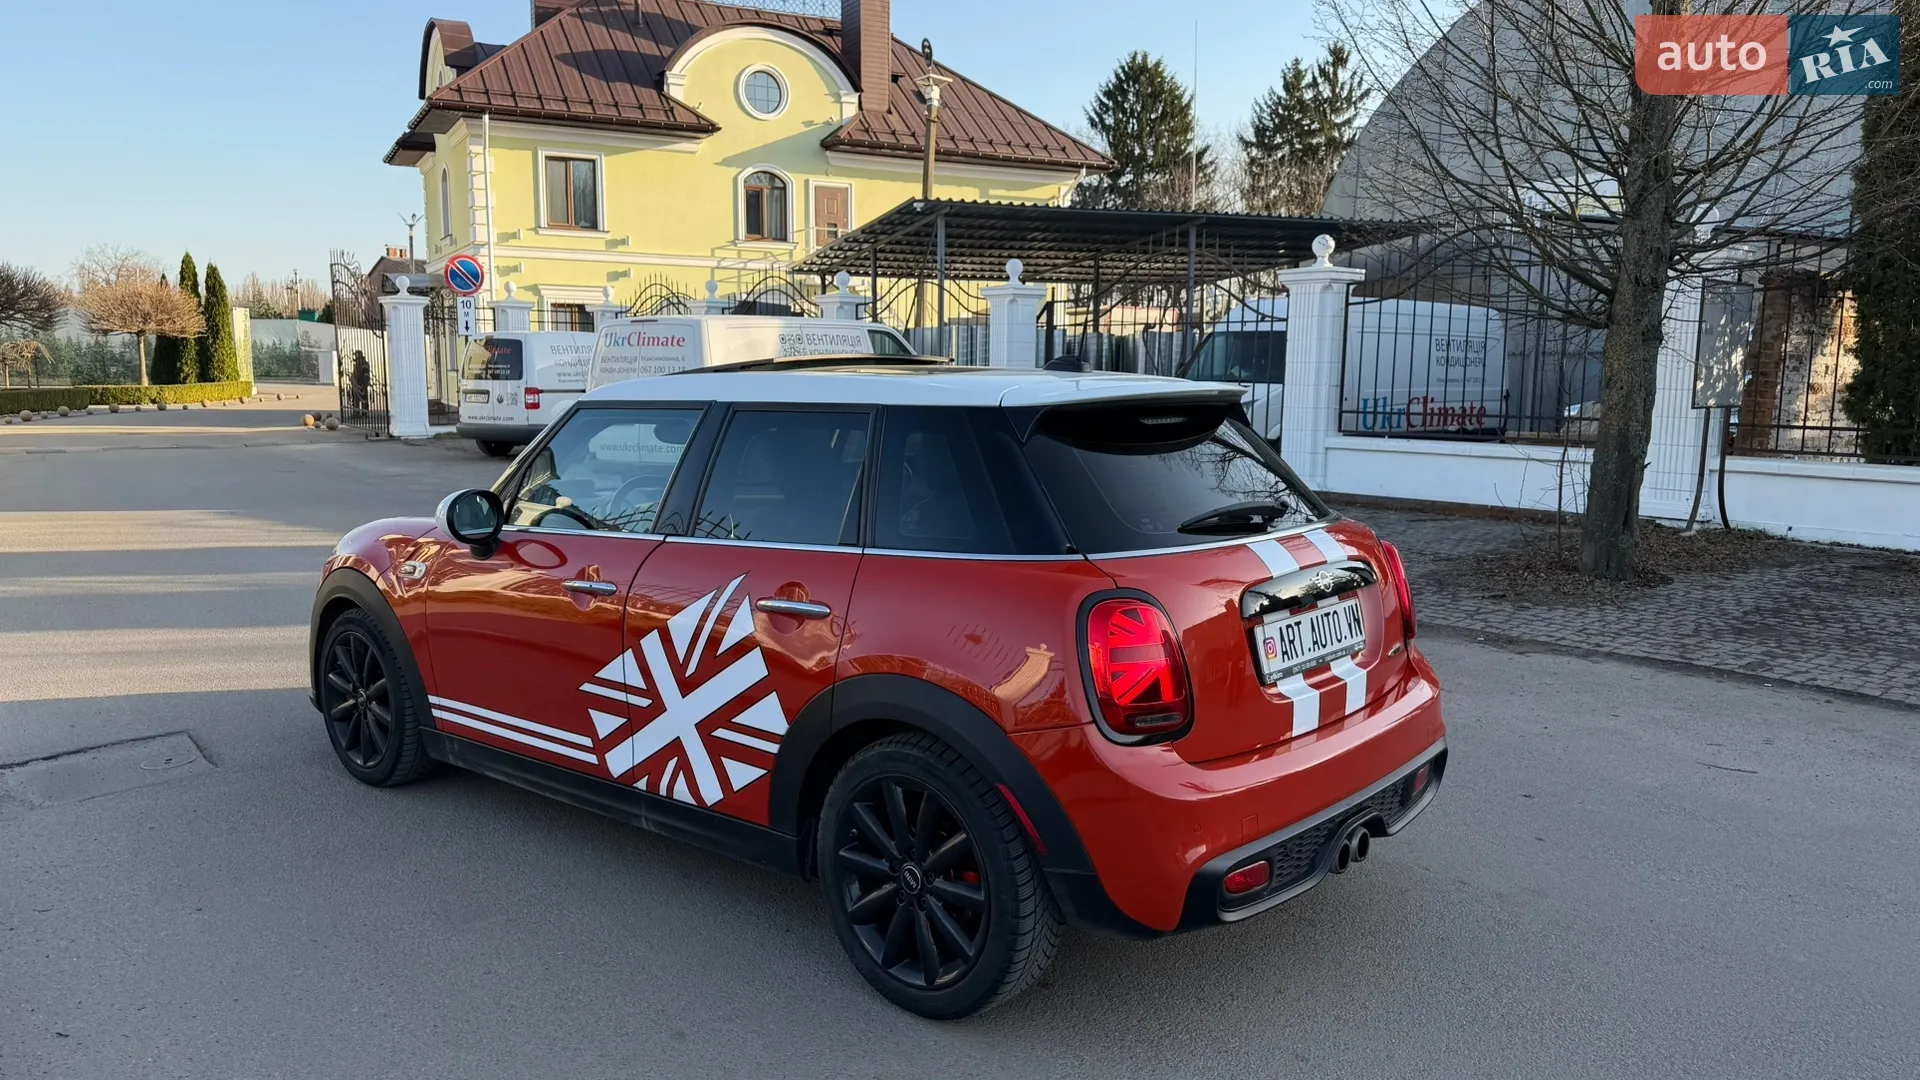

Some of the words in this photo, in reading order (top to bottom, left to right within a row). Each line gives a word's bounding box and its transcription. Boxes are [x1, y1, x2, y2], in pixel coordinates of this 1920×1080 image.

[460, 299, 472, 309] 10
[604, 331, 685, 348] UkrClimate
[805, 334, 862, 348] ВЕНТИЛЯЦІЯ
[550, 344, 594, 355] ВЕНТИЛЯ
[640, 366, 652, 374] 067
[653, 366, 666, 374] 100
[1361, 396, 1486, 430] UkrClimate
